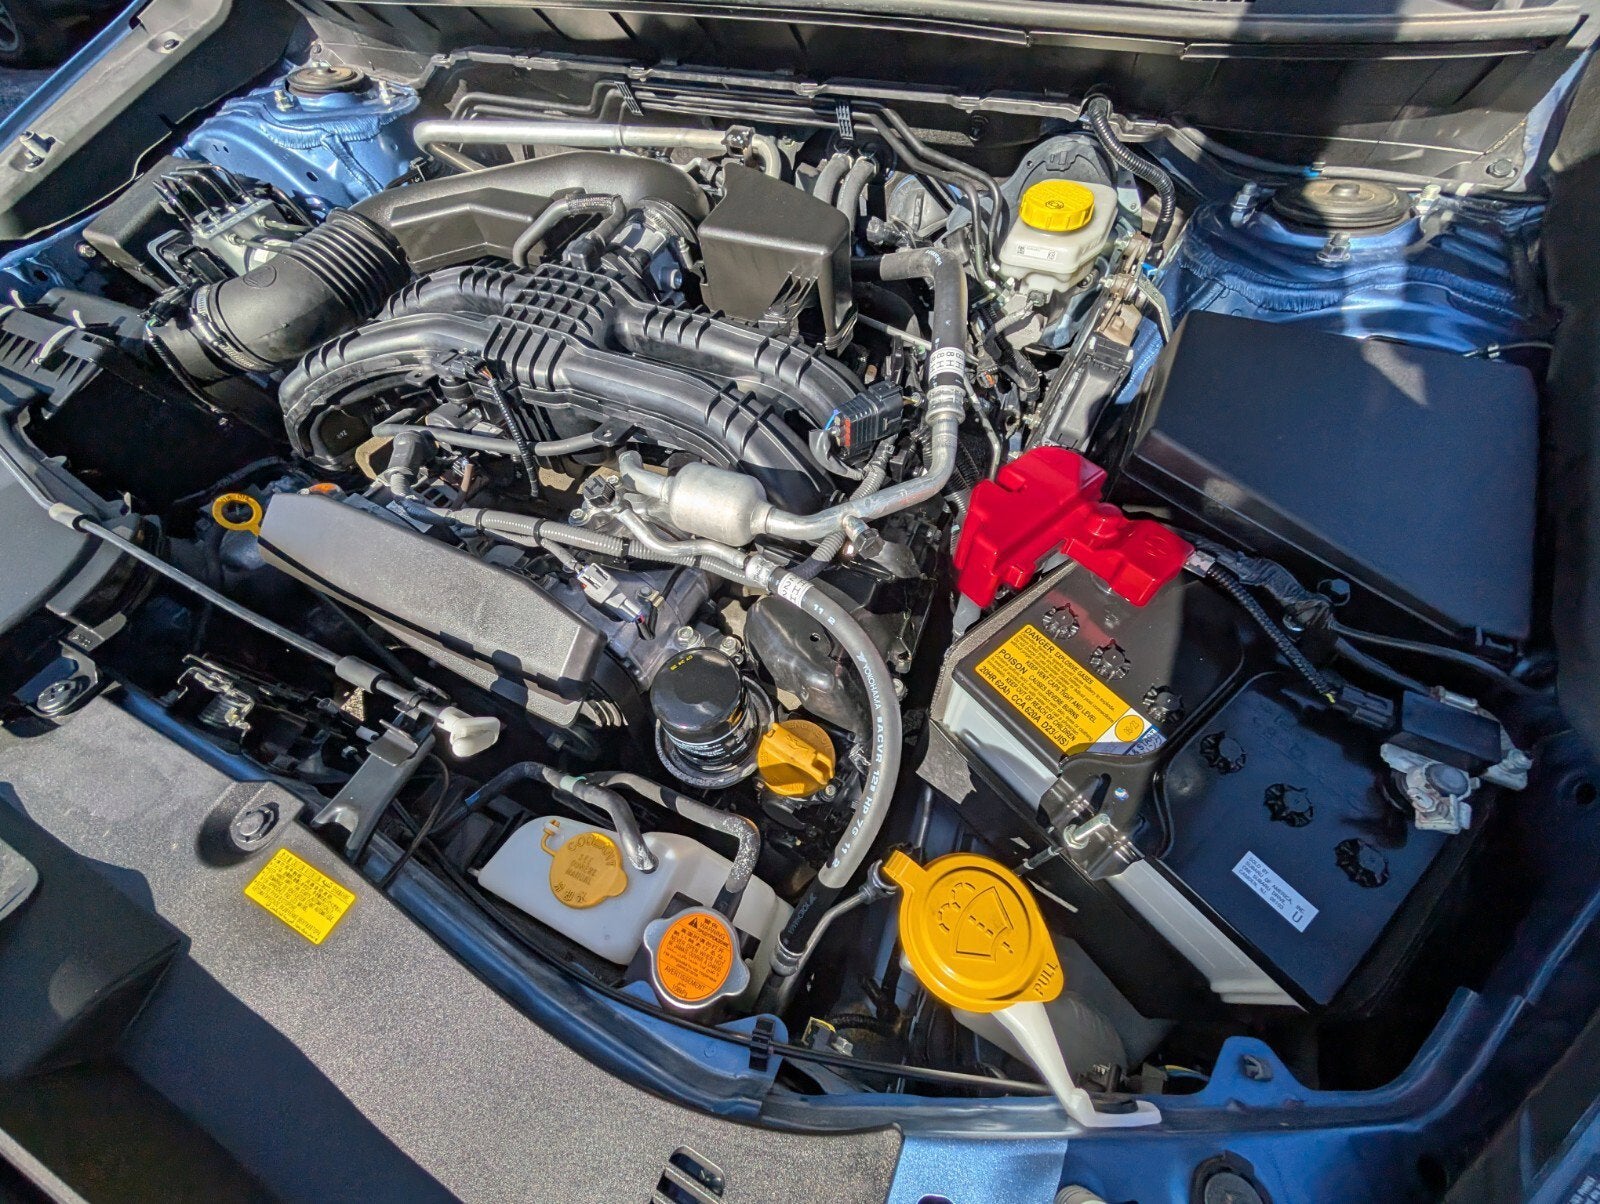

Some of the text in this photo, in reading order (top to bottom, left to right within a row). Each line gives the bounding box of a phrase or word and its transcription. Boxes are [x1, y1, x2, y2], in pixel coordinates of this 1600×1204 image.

[1023, 627, 1094, 684] DANGER EXPLOSIVE GASES
[862, 663, 882, 710] YOKOHAMA
[978, 665, 997, 682] 20HR
[994, 678, 1012, 695] 62Ah
[1010, 693, 1027, 709] CCA
[1023, 705, 1042, 722] 620A
[998, 648, 1080, 719] POISON CAUSES SEVERE BURNS
[1004, 676, 1076, 741] KEEP OUT OF REACH OF CHILDREN
[1024, 660, 1038, 671] KEEP
[1035, 669, 1049, 681] VENT
[1046, 678, 1061, 691] CAPS
[1058, 689, 1074, 702] TIGHT
[1070, 699, 1084, 710] AND
[1292, 911, 1302, 923] U
[1034, 963, 1058, 997] PULL
